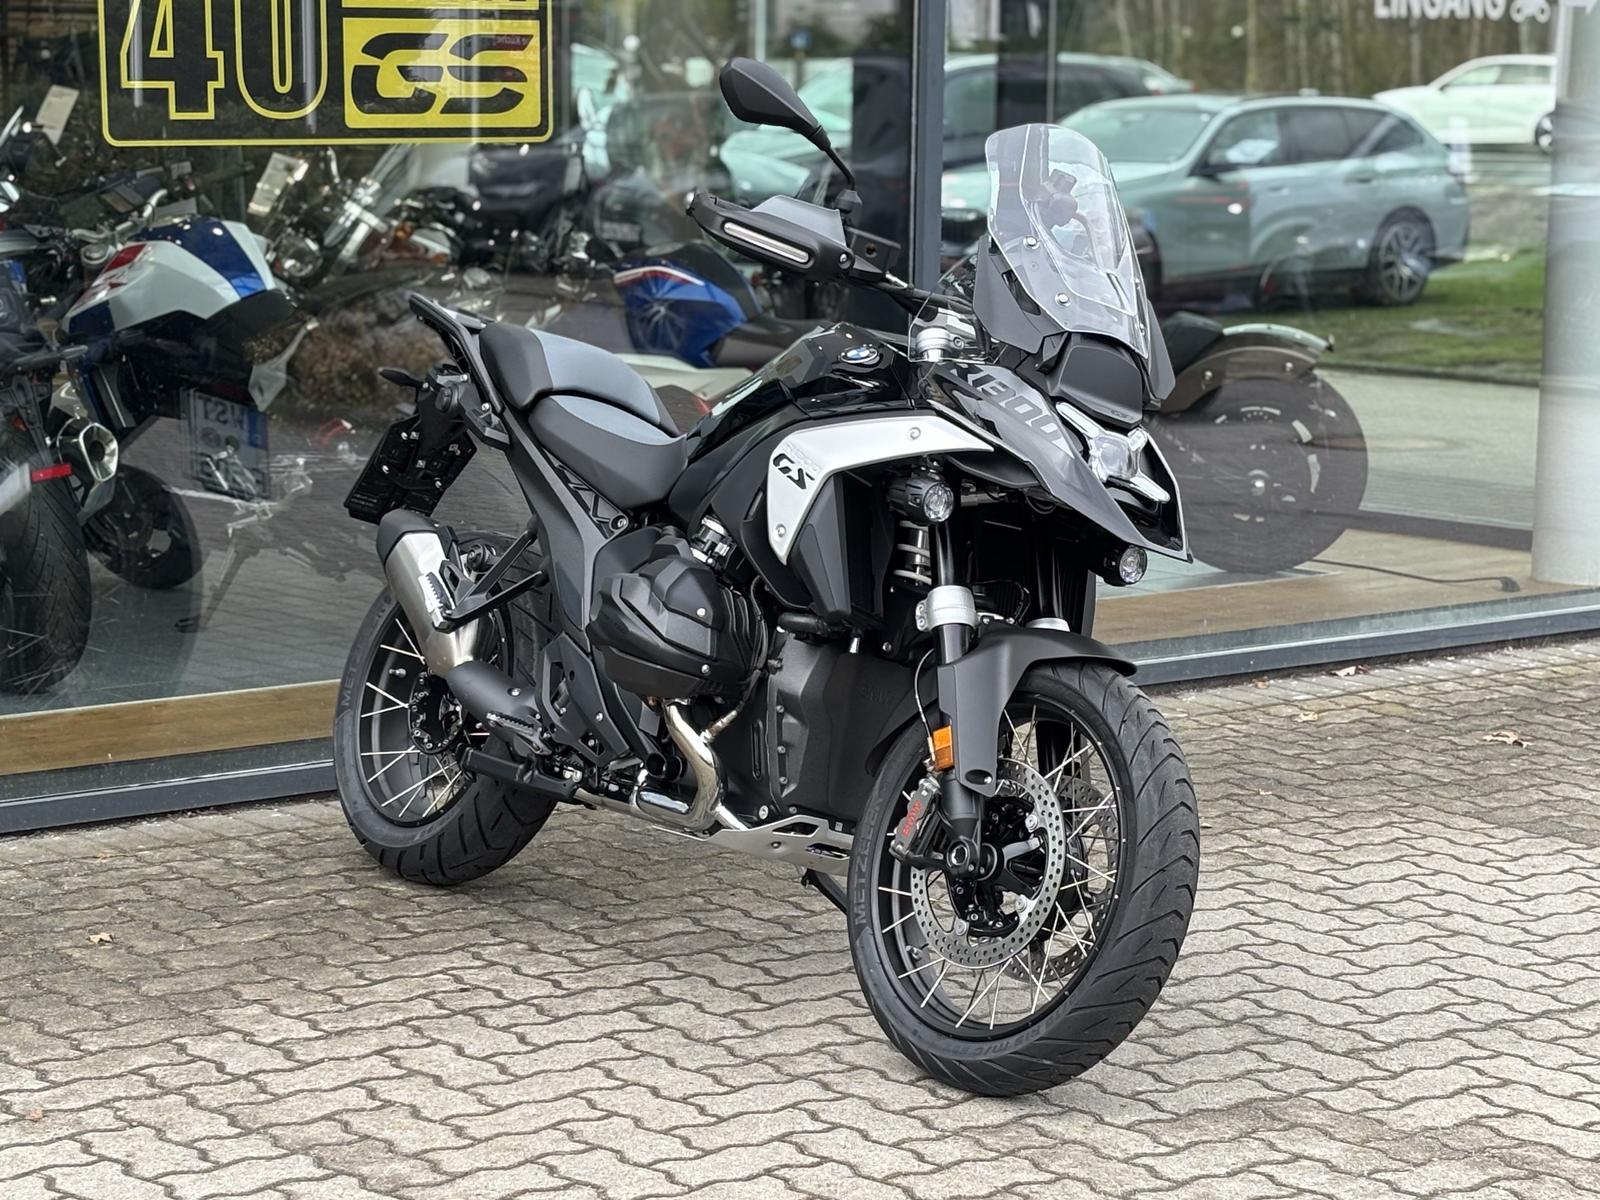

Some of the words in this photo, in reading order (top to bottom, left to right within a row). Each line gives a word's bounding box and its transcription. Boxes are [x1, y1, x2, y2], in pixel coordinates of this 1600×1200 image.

[120, 0, 328, 120] 40
[351, 33, 534, 115] GS
[773, 453, 816, 490] GS
